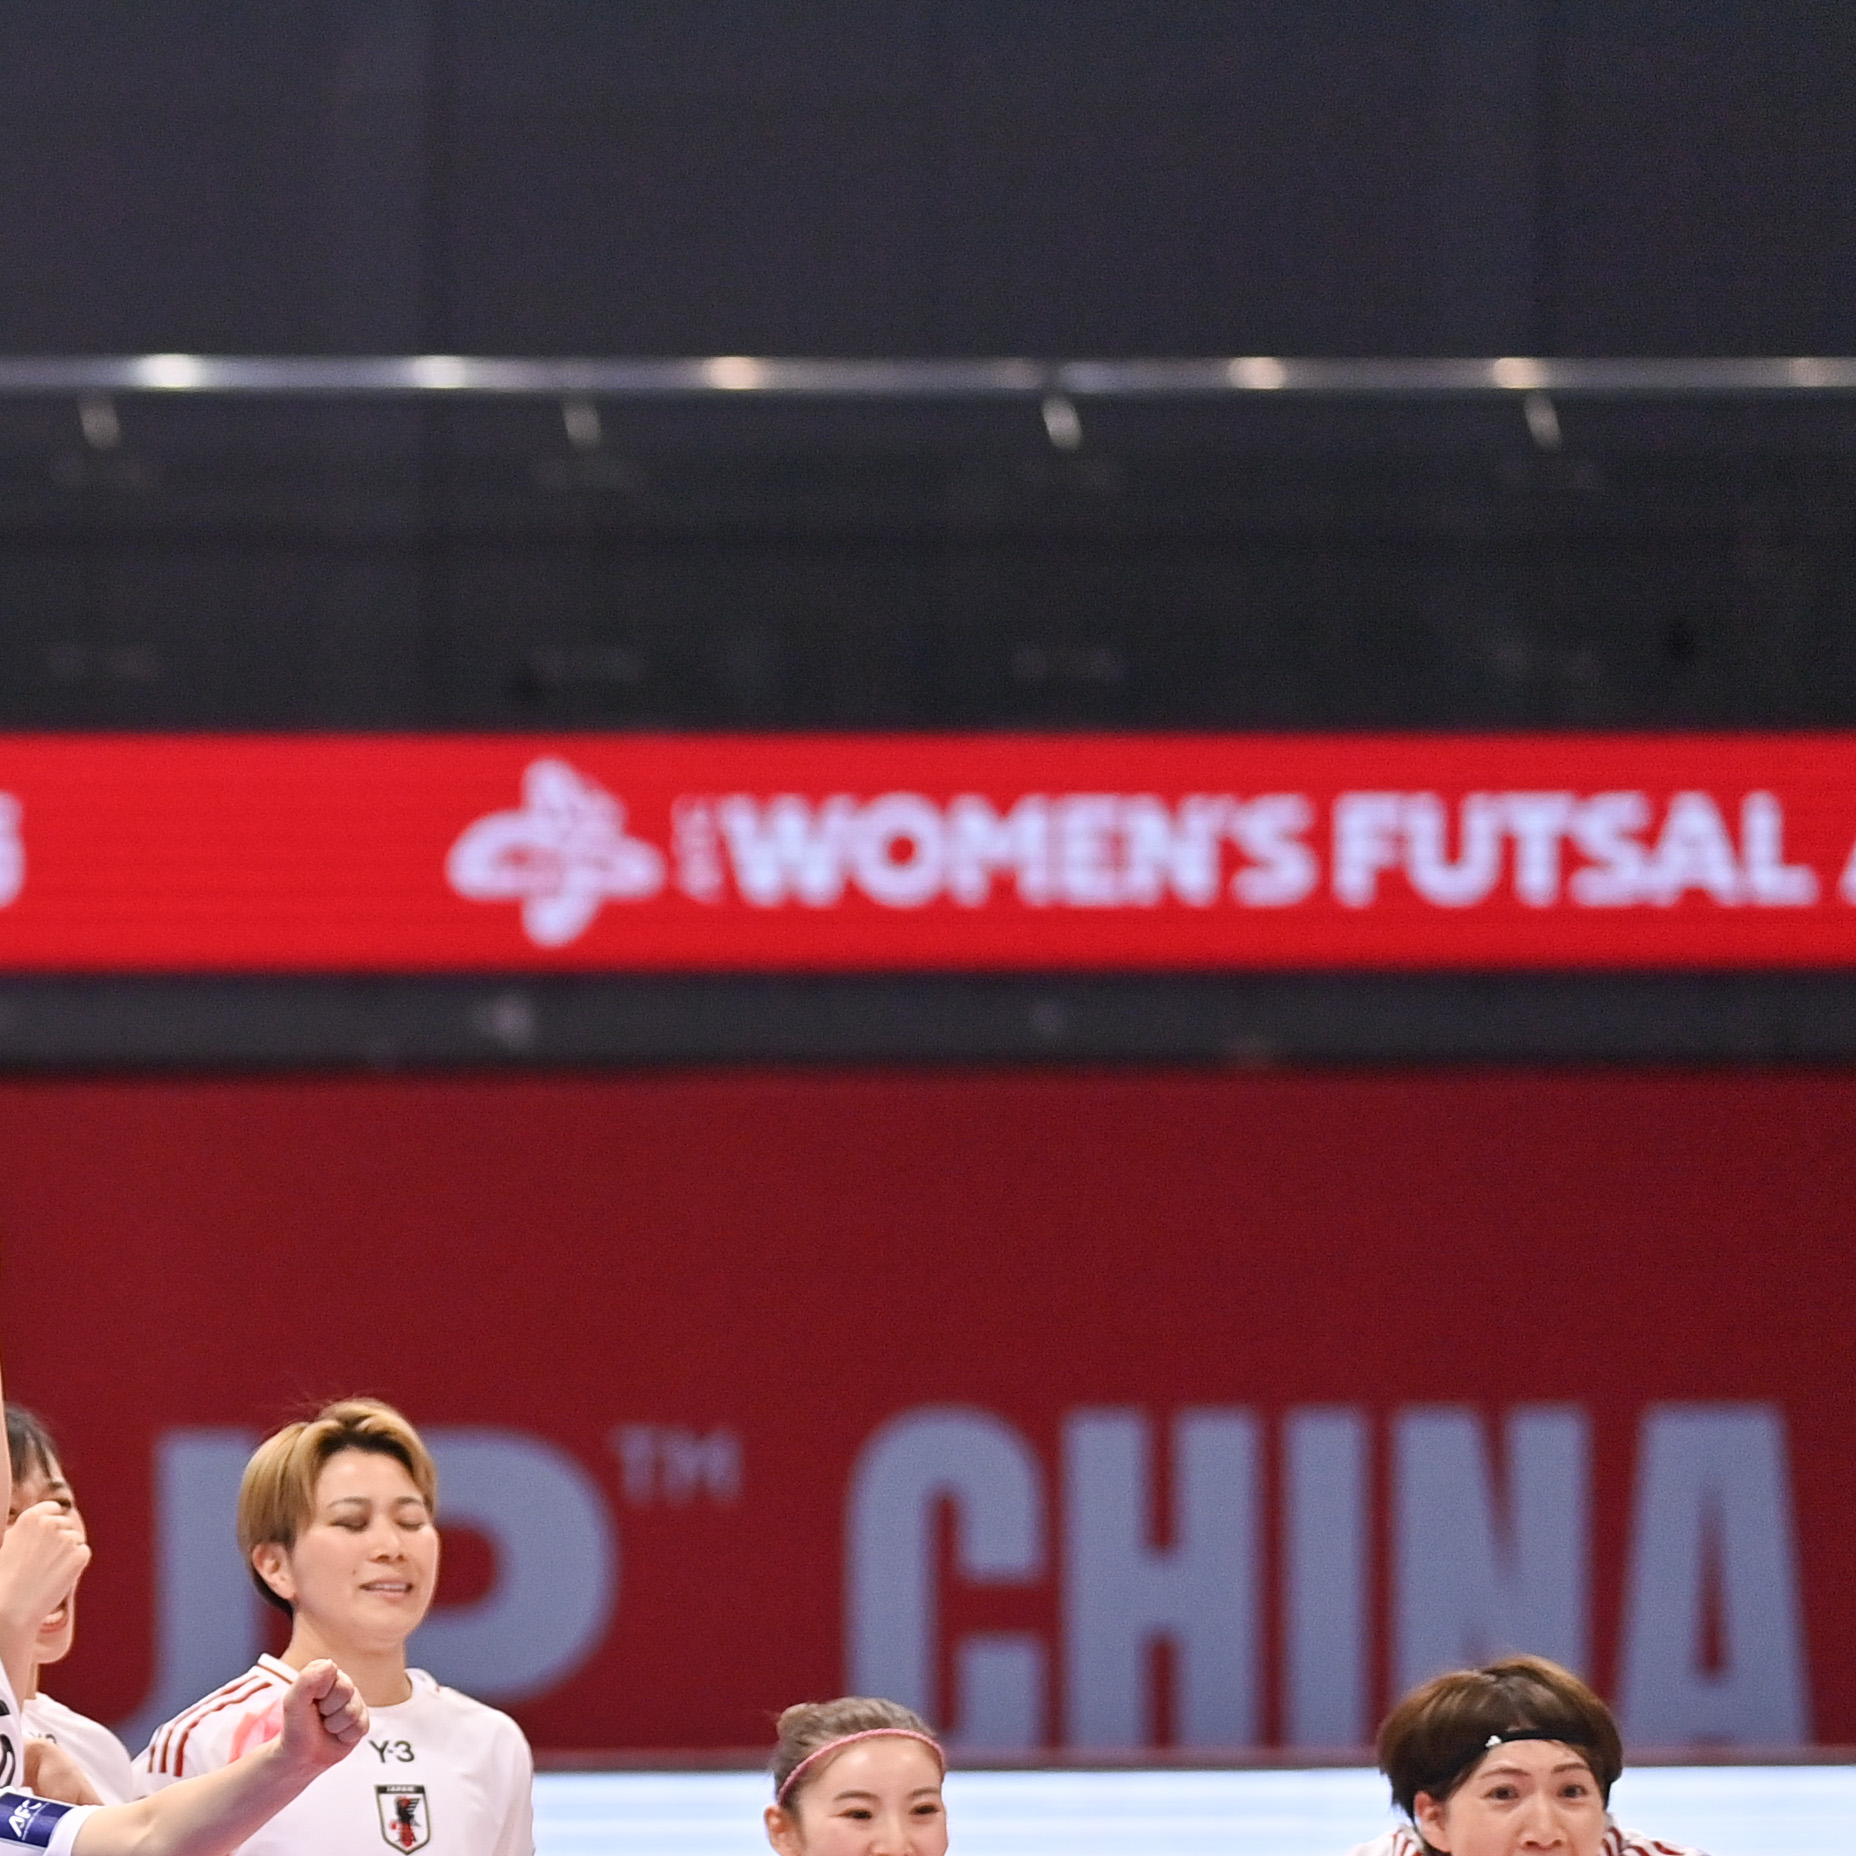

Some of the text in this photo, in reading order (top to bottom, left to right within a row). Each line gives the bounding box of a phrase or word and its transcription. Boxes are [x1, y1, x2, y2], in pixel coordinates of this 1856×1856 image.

[718, 792, 1320, 910] WOMEN'S
[1330, 788, 1821, 908] FUTSAL
[844, 1405, 1820, 1755] CHINA
[369, 1739, 415, 1764] Y-3
[8, 1801, 42, 1838] AFC
